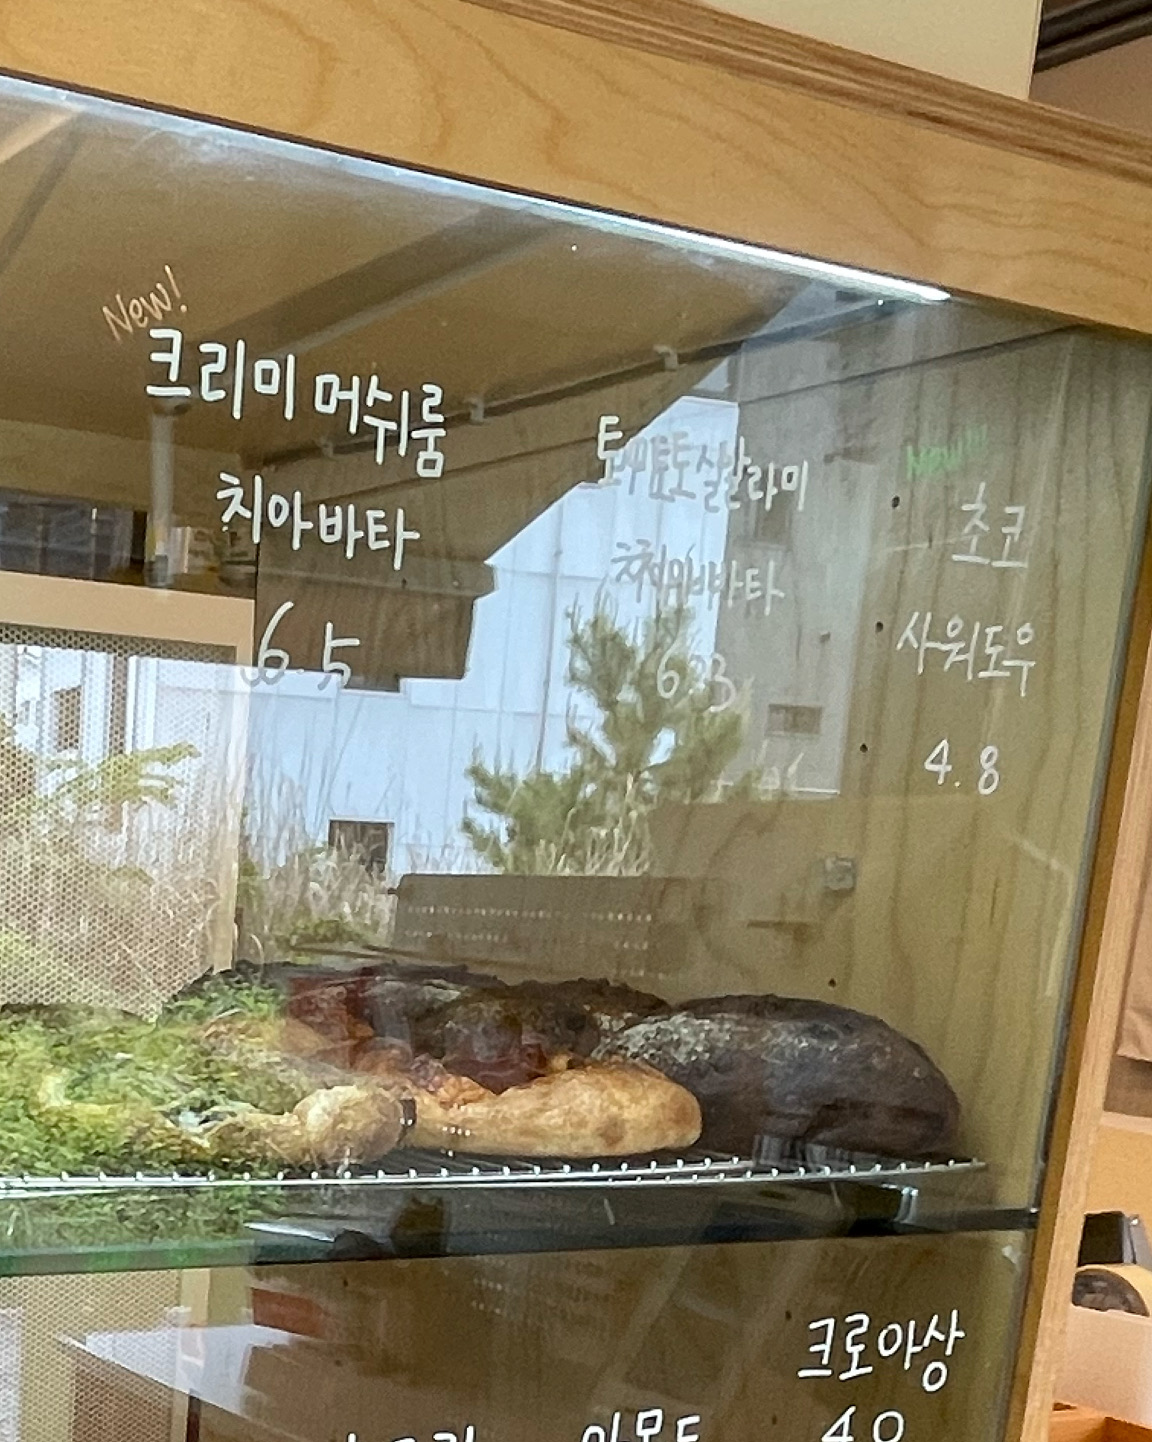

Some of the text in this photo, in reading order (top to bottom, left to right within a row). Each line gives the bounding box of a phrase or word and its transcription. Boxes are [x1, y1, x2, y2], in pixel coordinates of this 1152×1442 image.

[102, 265, 188, 341] New!
[146, 328, 447, 478] 크리미 머쉬룸
[217, 472, 421, 570] 치아바타
[952, 481, 1029, 568] 초코
[897, 611, 1036, 697] 사워도우
[924, 740, 1000, 795] 4.8
[797, 1309, 965, 1391] 크로아상
